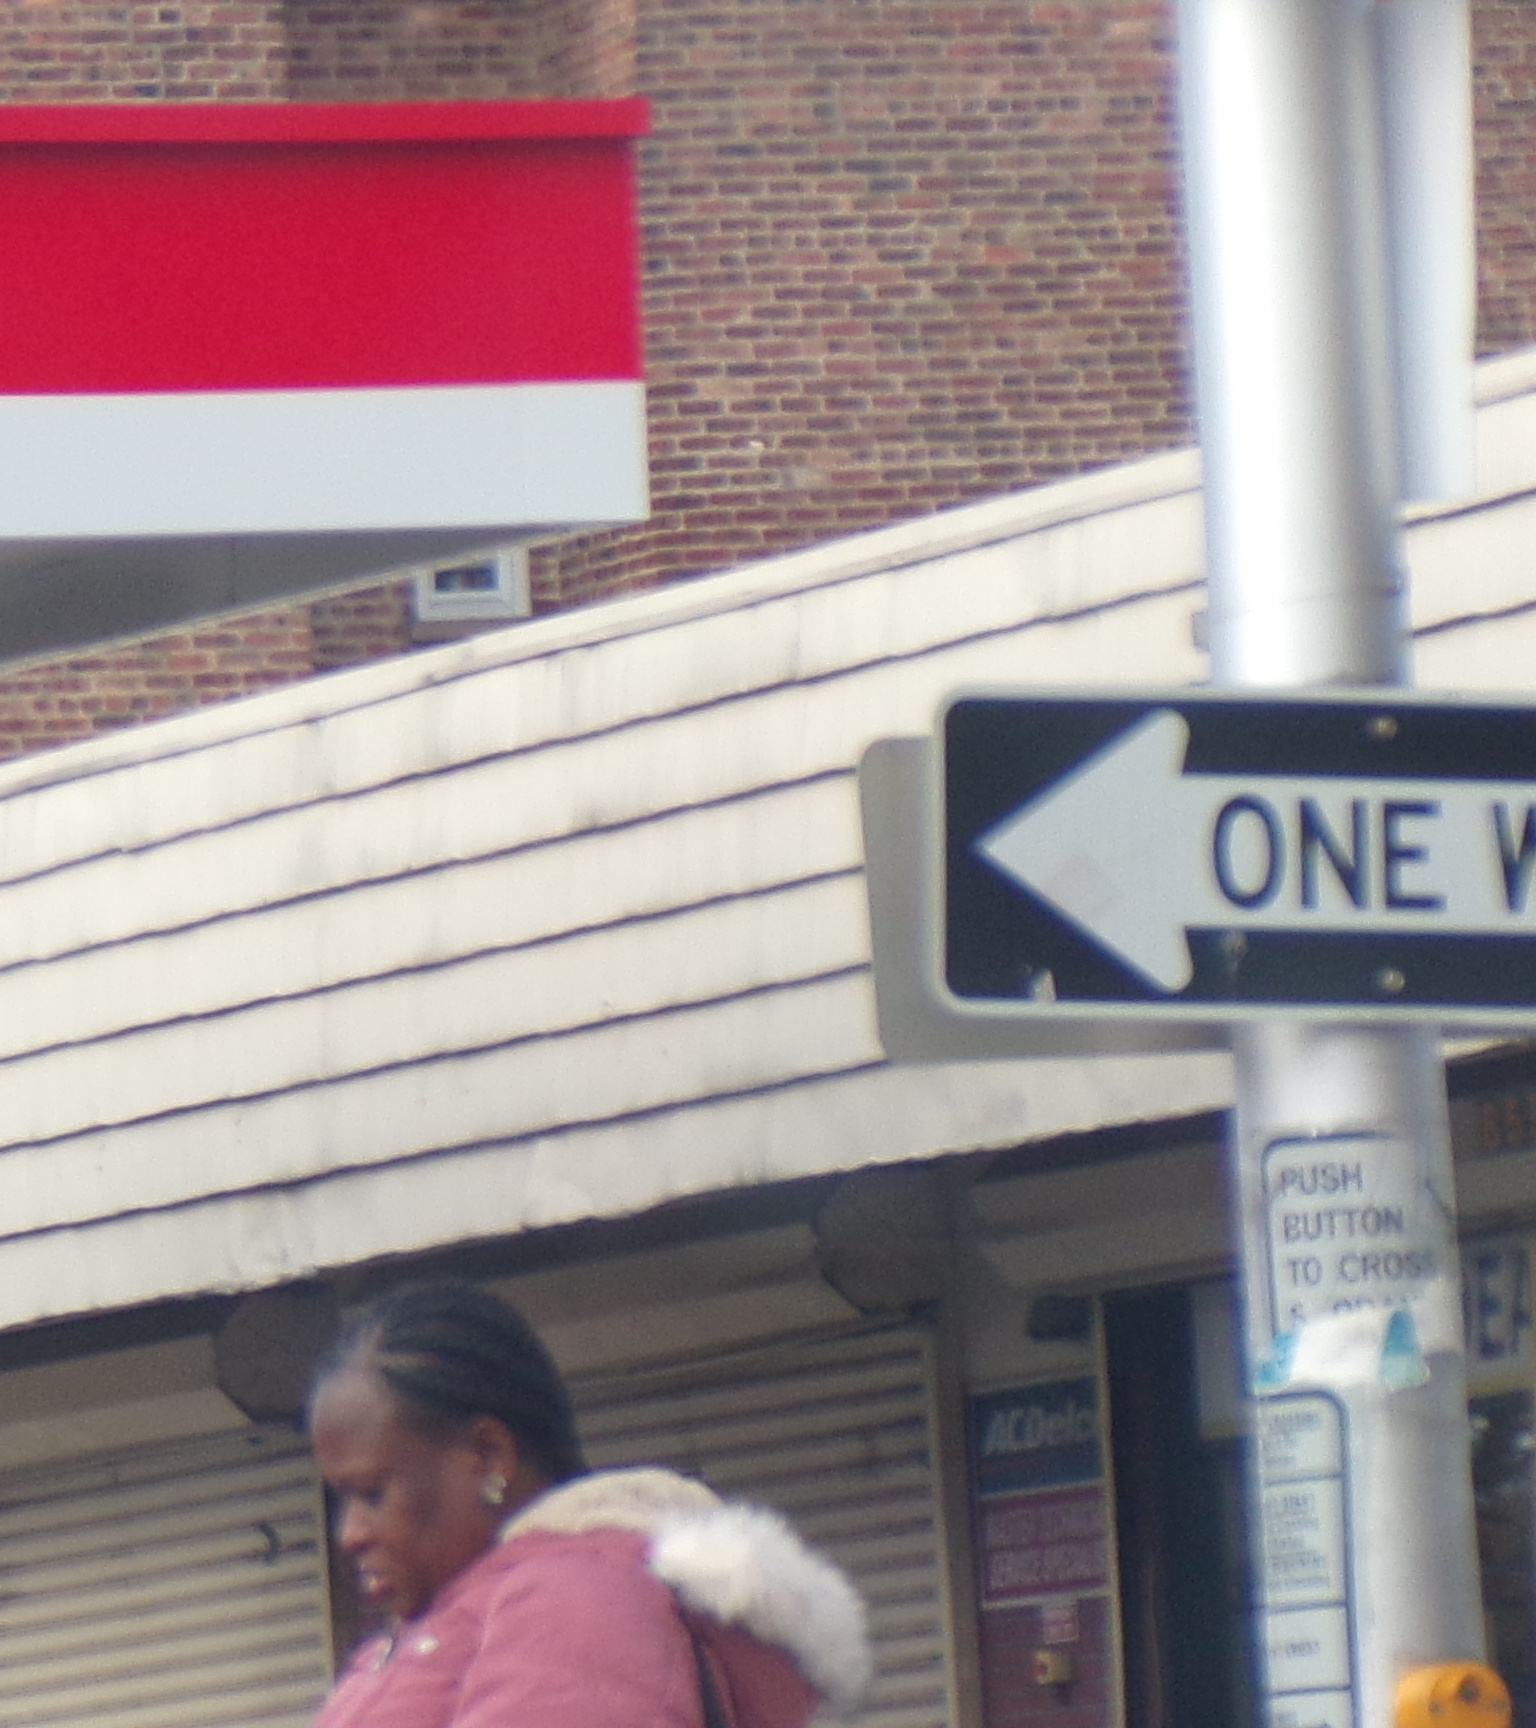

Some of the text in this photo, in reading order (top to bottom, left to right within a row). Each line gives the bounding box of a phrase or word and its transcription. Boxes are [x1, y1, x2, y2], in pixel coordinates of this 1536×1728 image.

[1212, 794, 1447, 913] ONE
[1280, 1161, 1364, 1197] PUSH
[1282, 1206, 1405, 1244] BUTTON
[1287, 1256, 1323, 1287] TO
